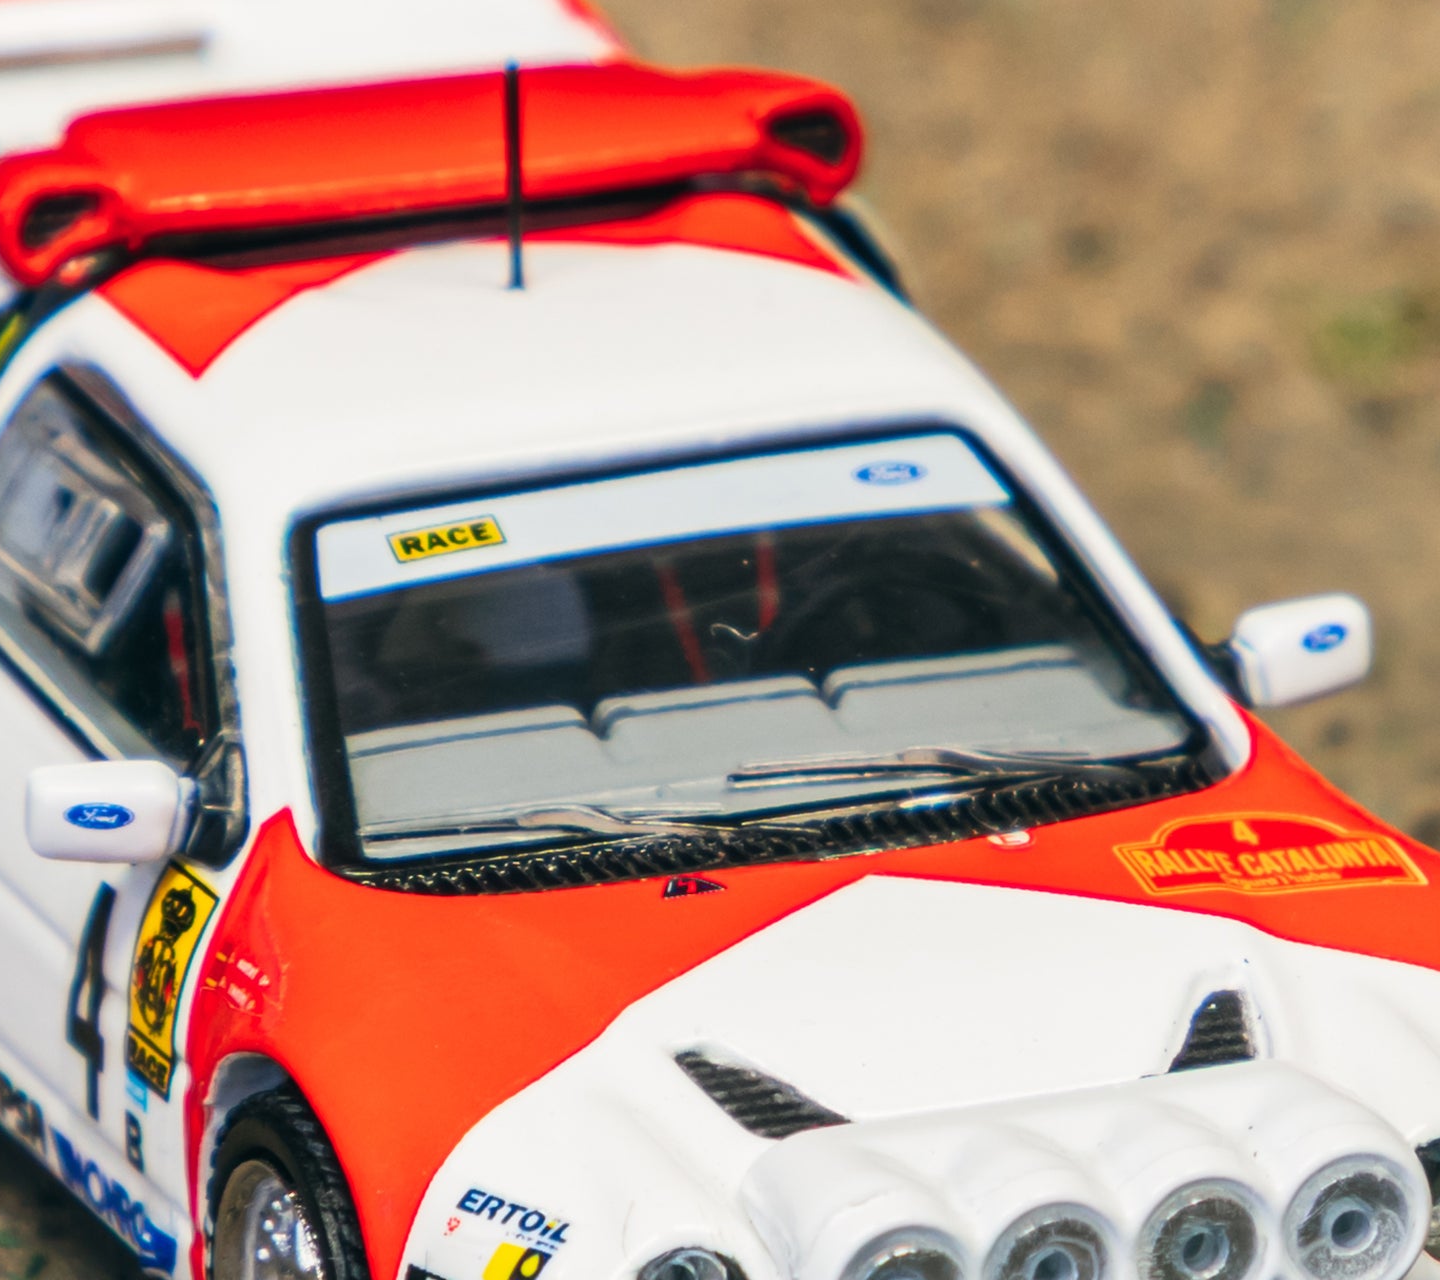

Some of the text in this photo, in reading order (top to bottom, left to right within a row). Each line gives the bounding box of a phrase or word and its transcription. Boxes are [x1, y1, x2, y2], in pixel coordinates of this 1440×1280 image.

[399, 521, 493, 555] RACE
[1231, 819, 1260, 845] 4
[1130, 838, 1398, 877] RALLYE CATALUNYA
[66, 880, 117, 1122] 4
